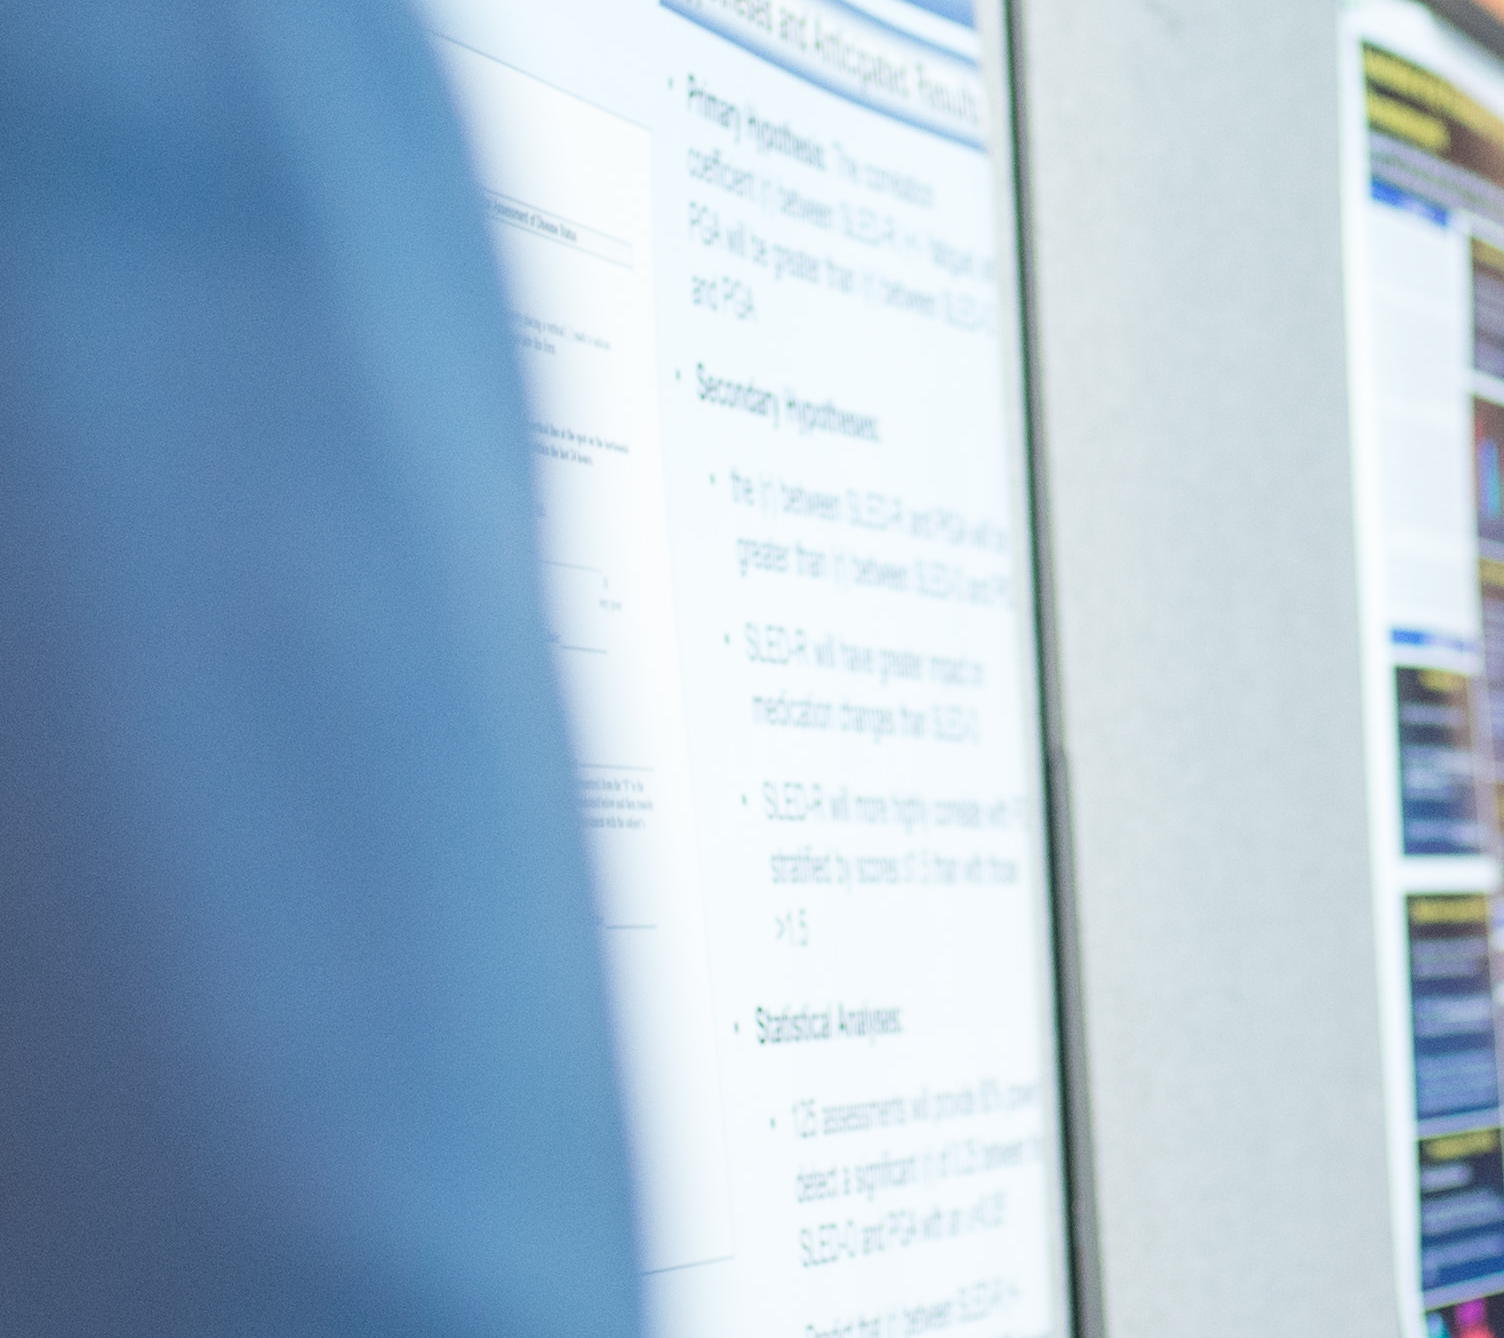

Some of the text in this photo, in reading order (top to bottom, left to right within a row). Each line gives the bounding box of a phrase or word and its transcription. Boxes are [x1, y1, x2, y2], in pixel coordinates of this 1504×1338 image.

[778, 6, 807, 52] and
[813, 16, 909, 107] Anticipated
[685, 73, 741, 144] Primary
[687, 200, 721, 247] PGA
[690, 274, 757, 321] and PGA
[695, 360, 780, 431] Secondary
[751, 690, 832, 729] medication
[754, 1003, 831, 1045] Statistical
